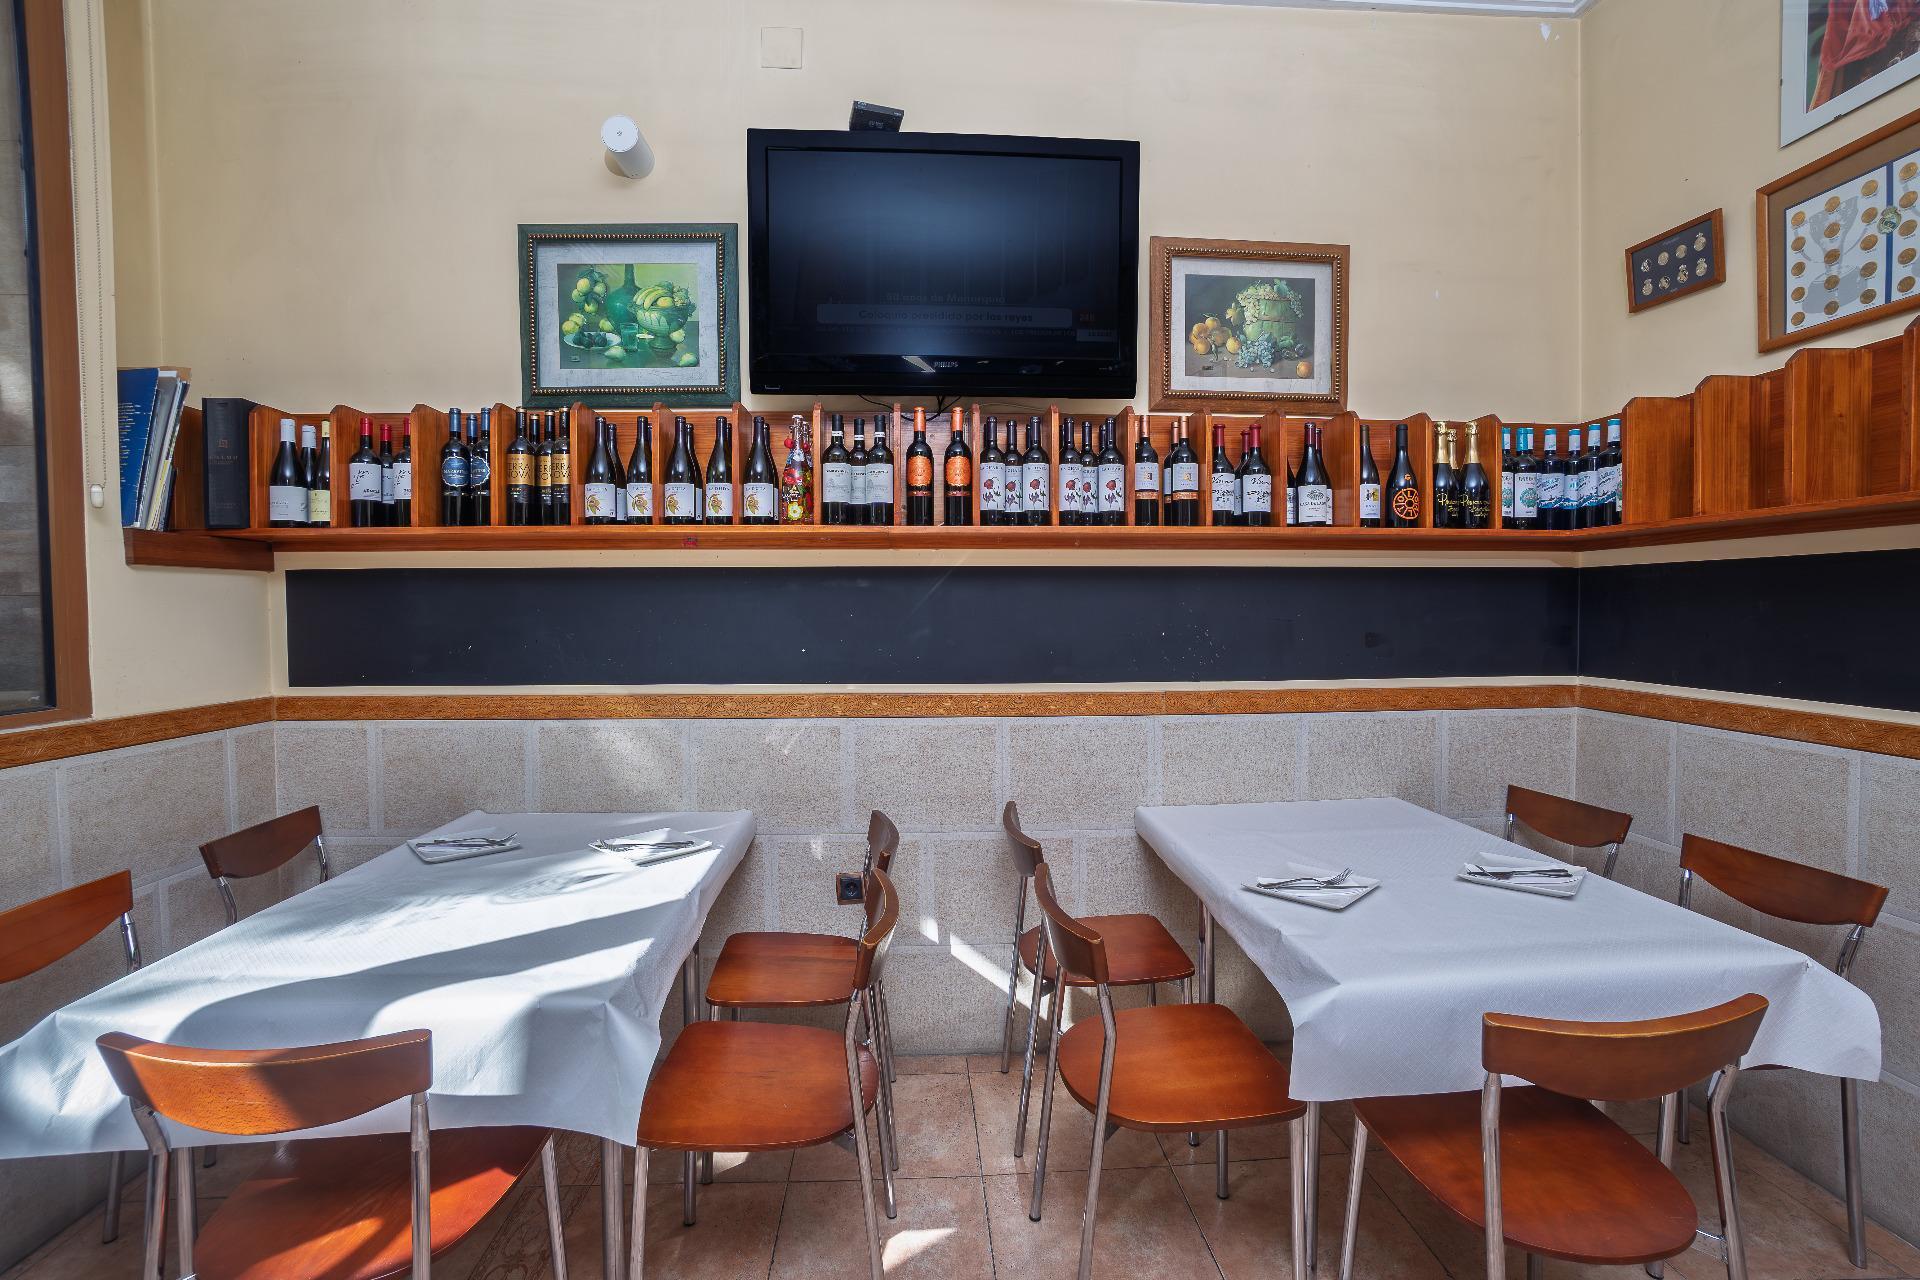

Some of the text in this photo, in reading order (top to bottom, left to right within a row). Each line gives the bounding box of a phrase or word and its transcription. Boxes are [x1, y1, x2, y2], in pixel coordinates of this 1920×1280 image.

[911, 311, 962, 322] presidido
[965, 311, 984, 323] por
[986, 311, 1002, 322] los
[1004, 313, 1033, 324] reyes
